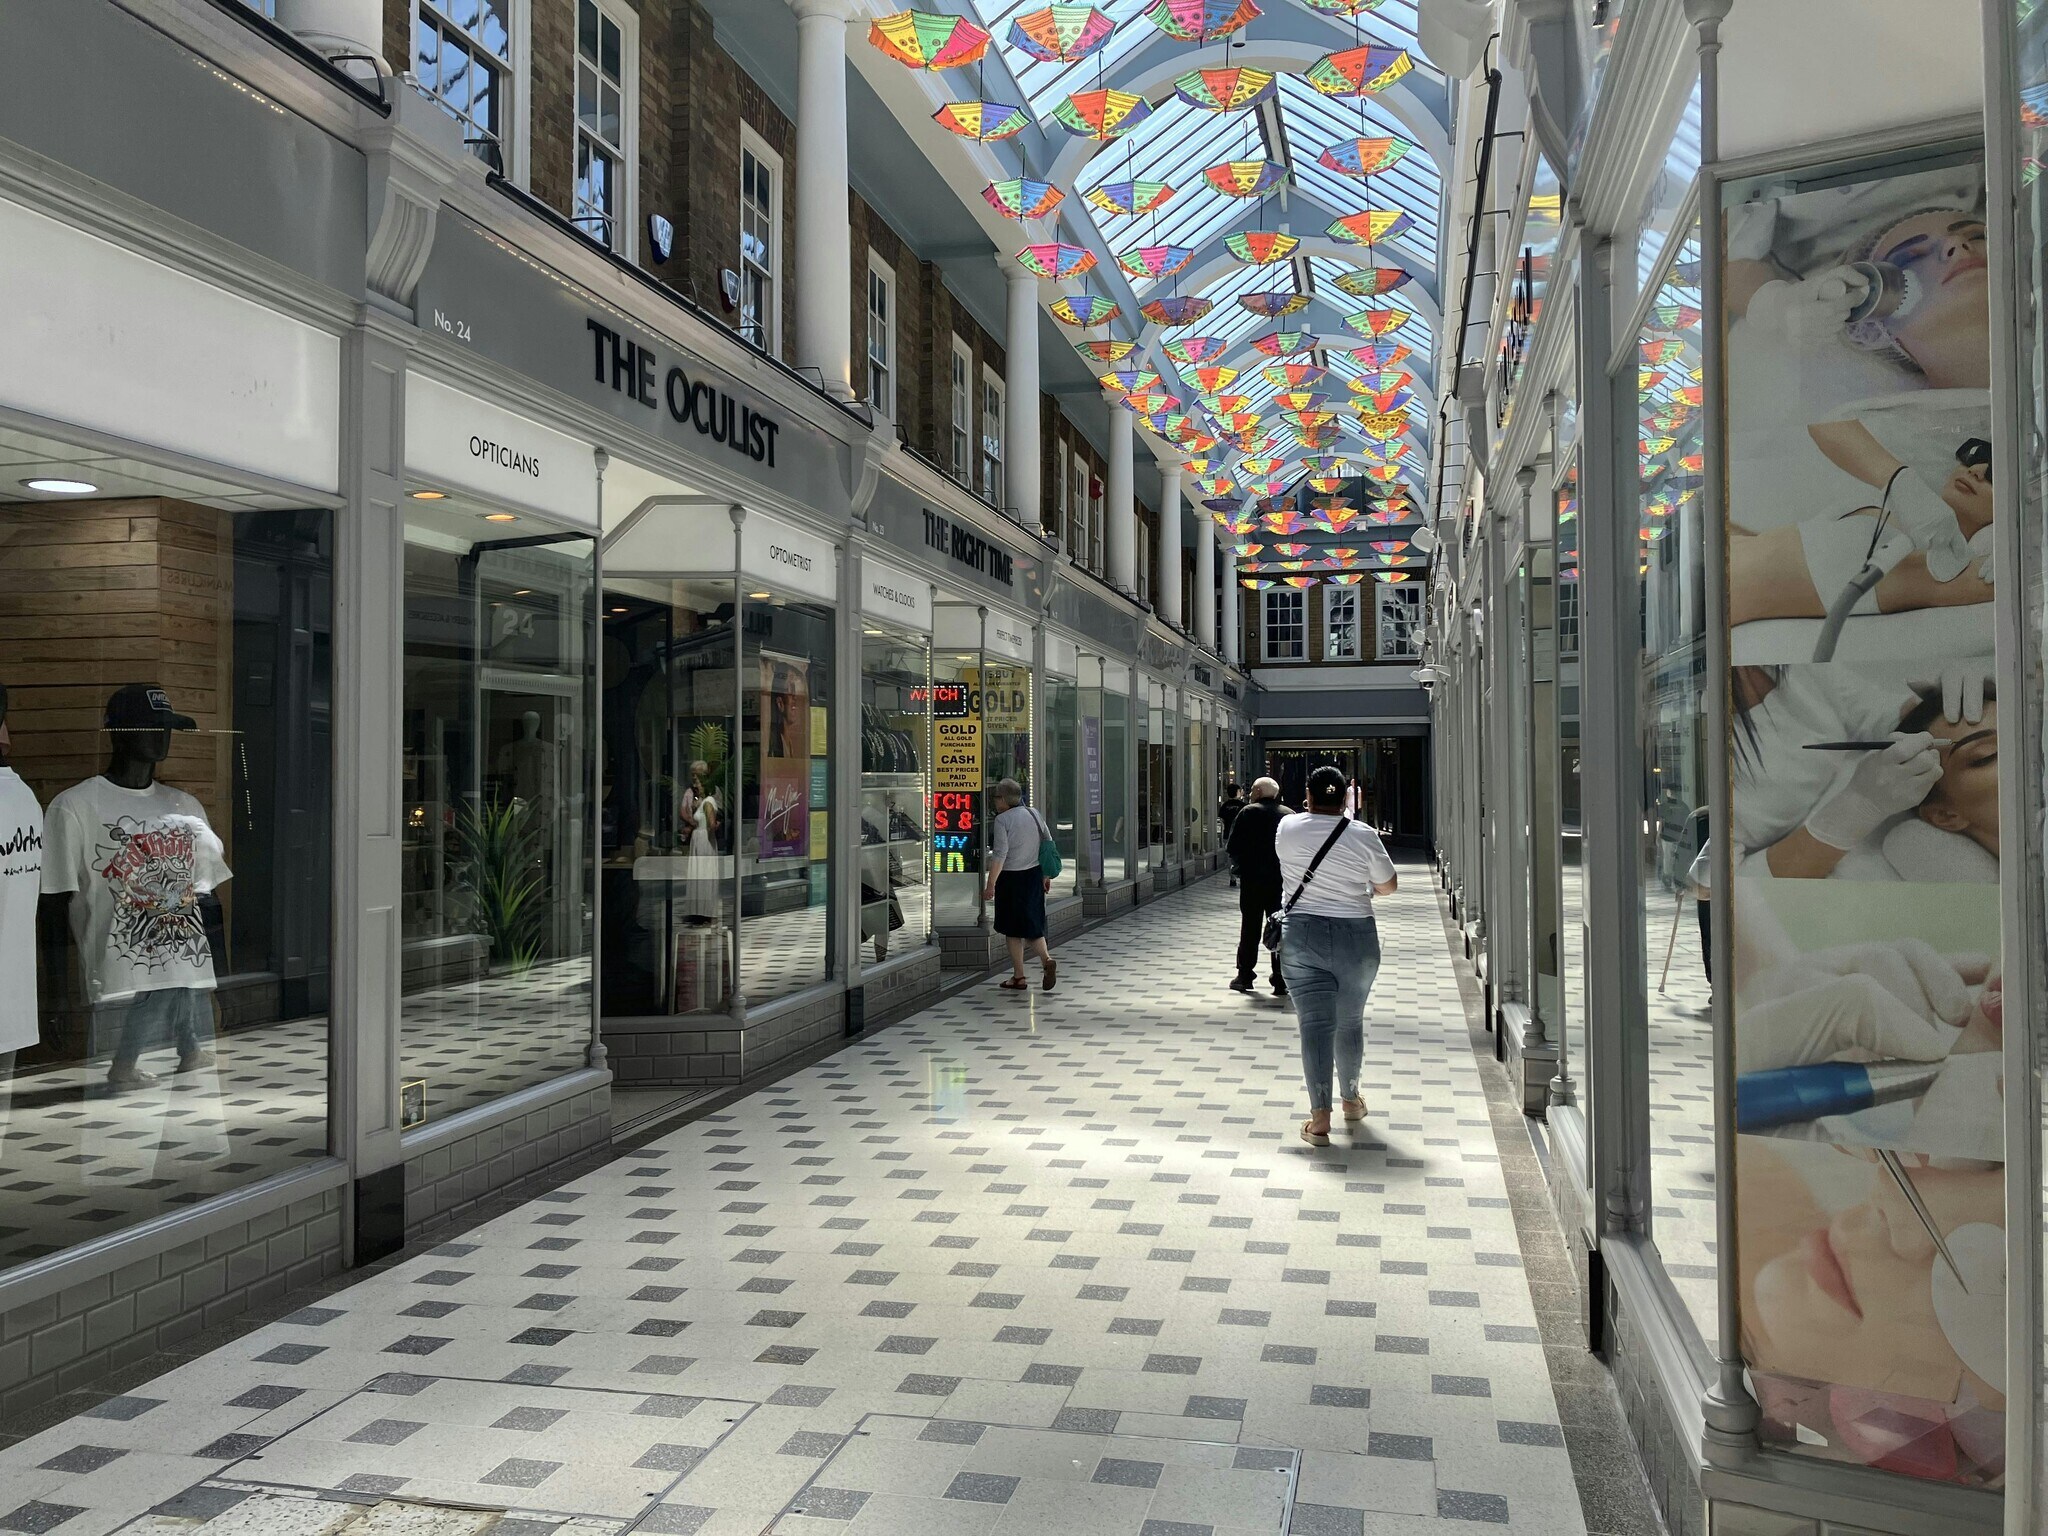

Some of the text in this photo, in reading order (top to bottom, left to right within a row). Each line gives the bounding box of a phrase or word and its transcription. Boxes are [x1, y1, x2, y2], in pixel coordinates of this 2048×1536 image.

[434, 309, 471, 342] No. 24
[587, 318, 779, 468] THE OCULIST
[469, 435, 540, 478] OPTICIANS
[769, 545, 812, 572] OPTOMETRIST
[922, 508, 1014, 587] THE RIGHT TIME
[872, 582, 915, 609] WATCHES & CLOCKS
[502, 609, 535, 639] 24
[969, 690, 1025, 713] GOLD
[939, 724, 977, 735] GOLD
[941, 755, 975, 764] CASH
[958, 811, 972, 830] &
